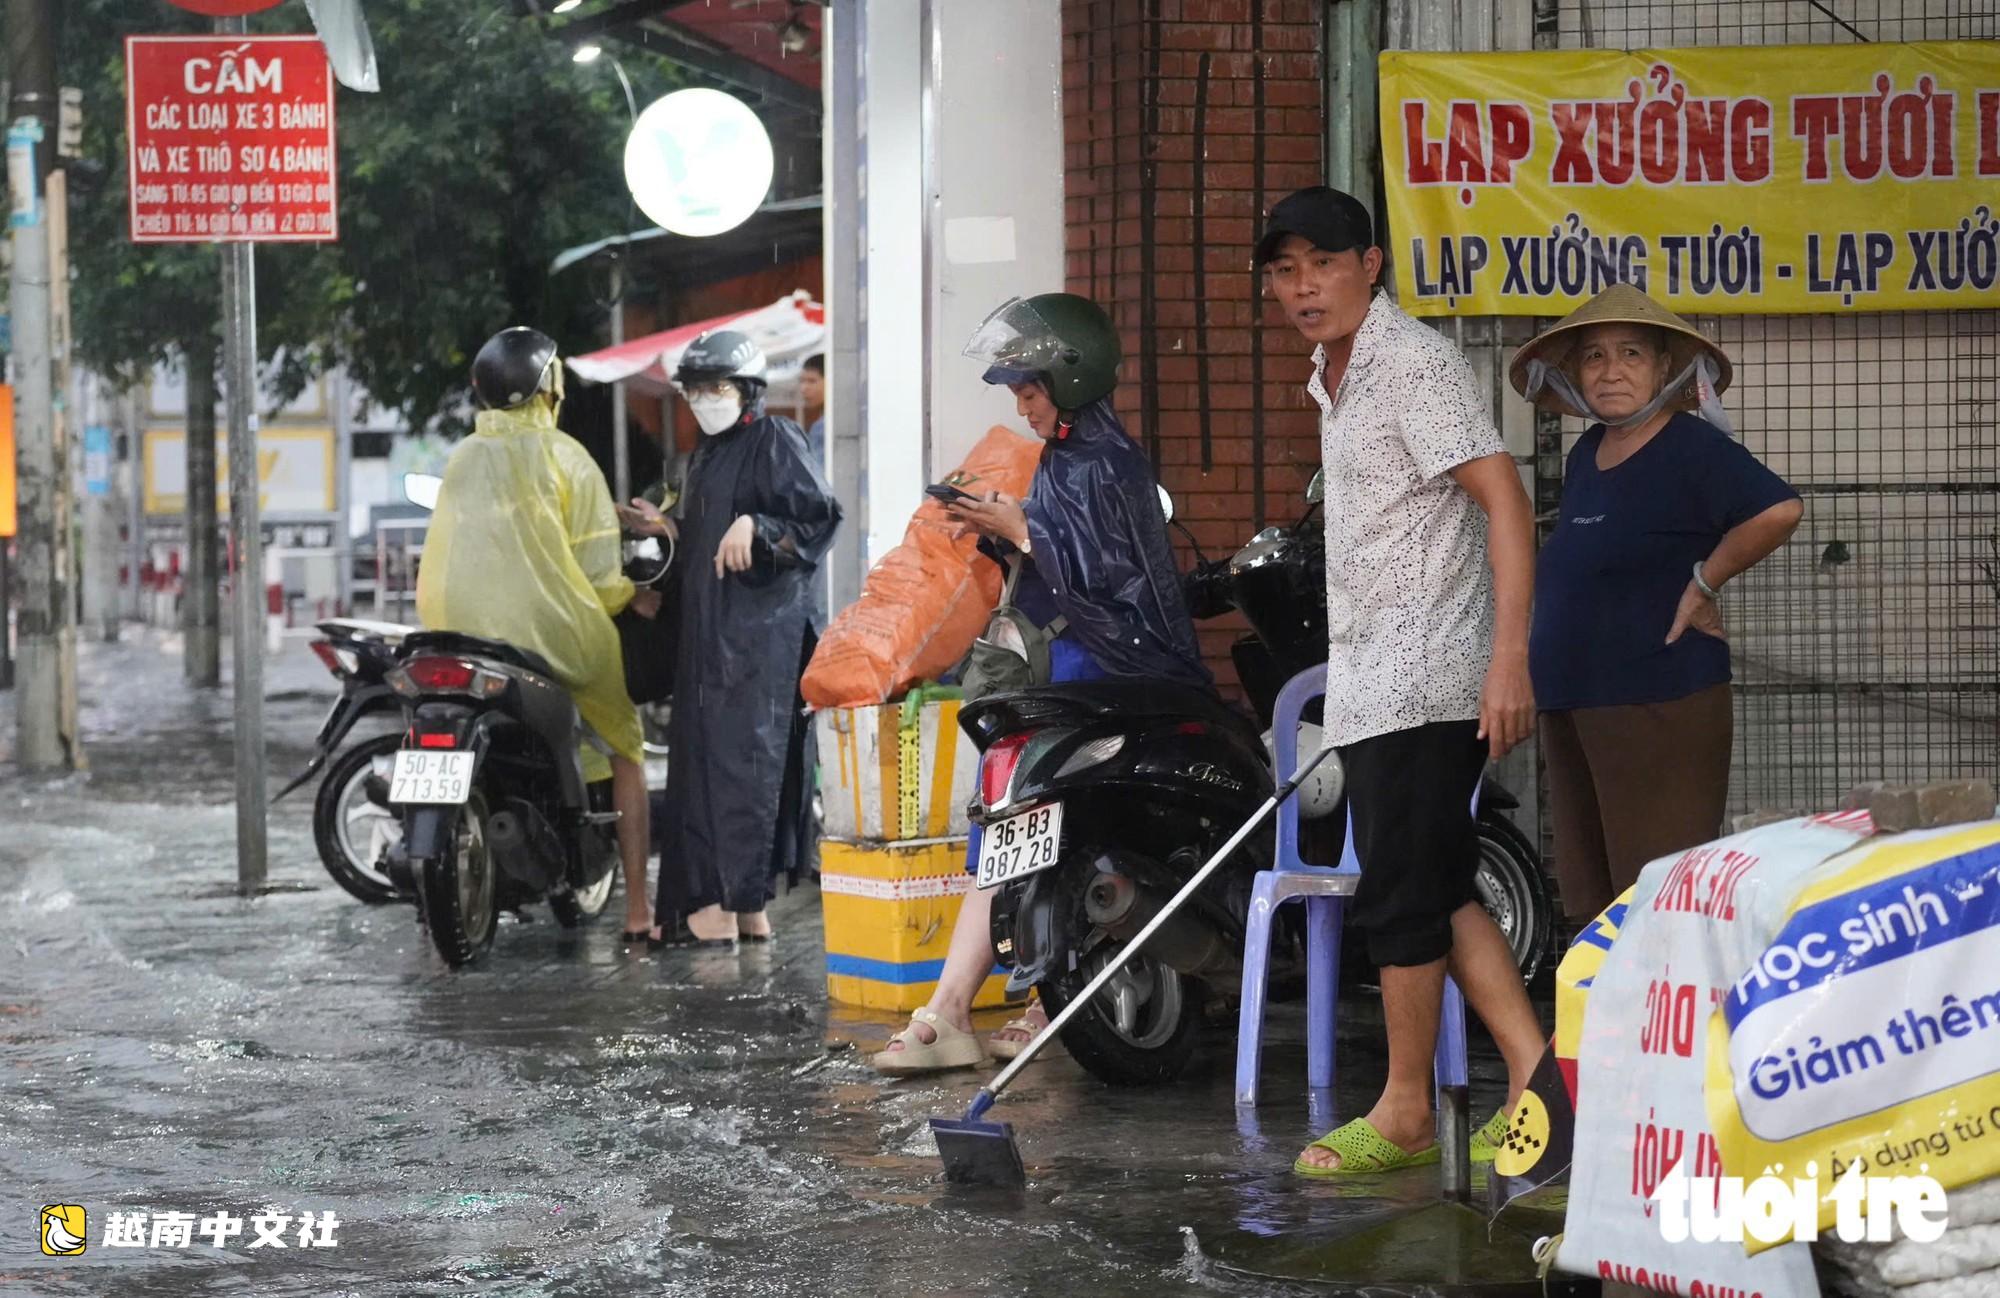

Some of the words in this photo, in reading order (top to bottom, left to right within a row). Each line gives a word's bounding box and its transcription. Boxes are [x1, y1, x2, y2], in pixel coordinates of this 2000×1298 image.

[184, 43, 282, 94] CẤM
[146, 96, 181, 130] CÁC
[188, 103, 228, 135] LOẠI
[236, 103, 257, 130] XE
[263, 103, 274, 130] 3
[279, 96, 326, 130] BÁNH
[1404, 102, 1533, 205] LẠP
[1552, 64, 1771, 184] XƯỞNG
[1794, 74, 1953, 180] TƯƠI
[137, 139, 161, 173] VÀ
[167, 146, 190, 173] XE
[198, 140, 232, 173] THÔ
[268, 147, 281, 173] 4
[284, 138, 330, 173] BÁNH
[1412, 236, 1488, 307] LẠP
[1501, 213, 1647, 296] XƯỞNG
[1661, 224, 1761, 294] TƯƠI
[1808, 233, 1893, 305] LẠP
[405, 754, 460, 775] 50-AC
[993, 808, 1050, 850] 36-B3
[984, 836, 1053, 881] 987.28
[1840, 885, 1950, 956] sinh
[1750, 1036, 1885, 1100] Giảm
[1876, 1130, 1950, 1168] dụng
